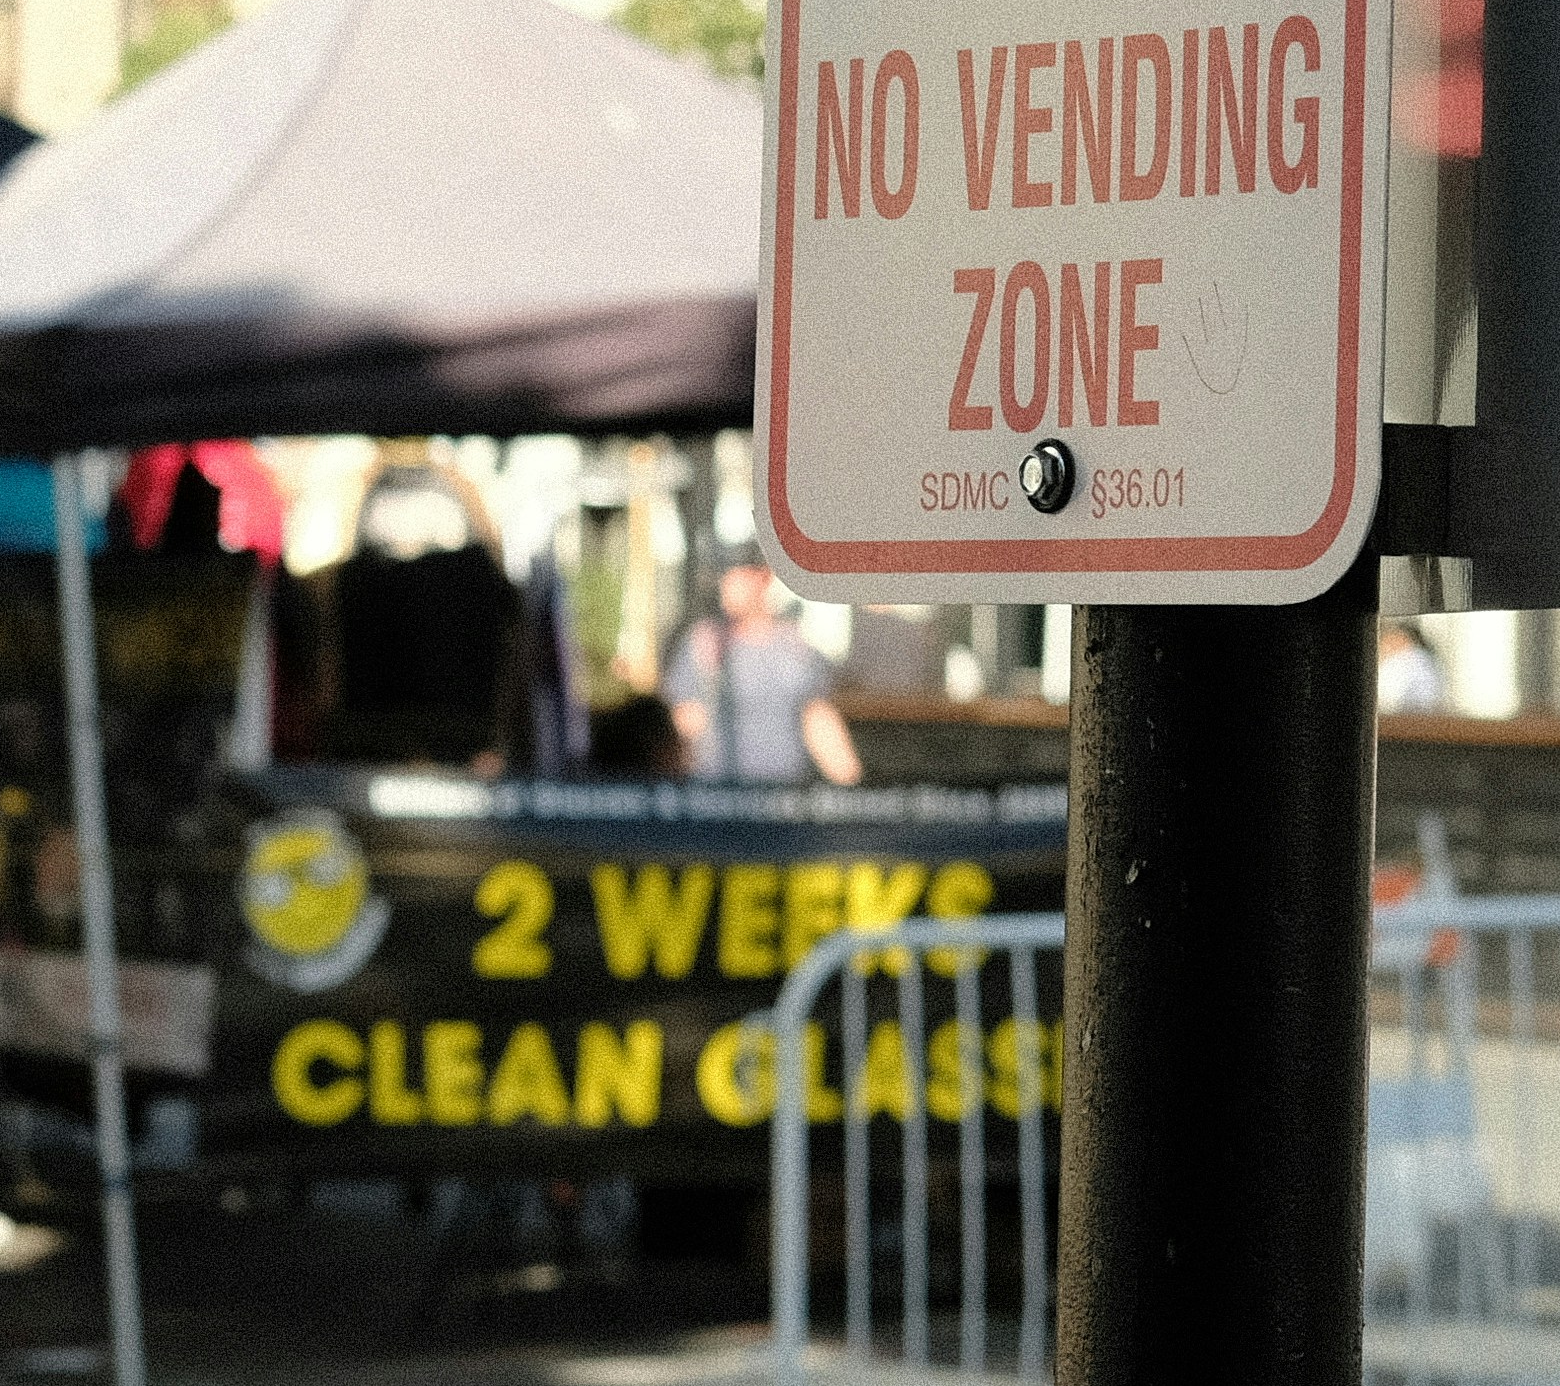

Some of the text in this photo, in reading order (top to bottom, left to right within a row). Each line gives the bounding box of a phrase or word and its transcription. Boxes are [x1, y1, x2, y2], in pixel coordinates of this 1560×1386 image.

[814, 15, 1321, 220] NO VENDING
[948, 257, 1164, 433] ZONE
[920, 466, 1185, 519] SDMC §36.01
[472, 859, 996, 980] 2 WEEKS
[271, 1018, 1065, 1129] CLEAN GLASS
